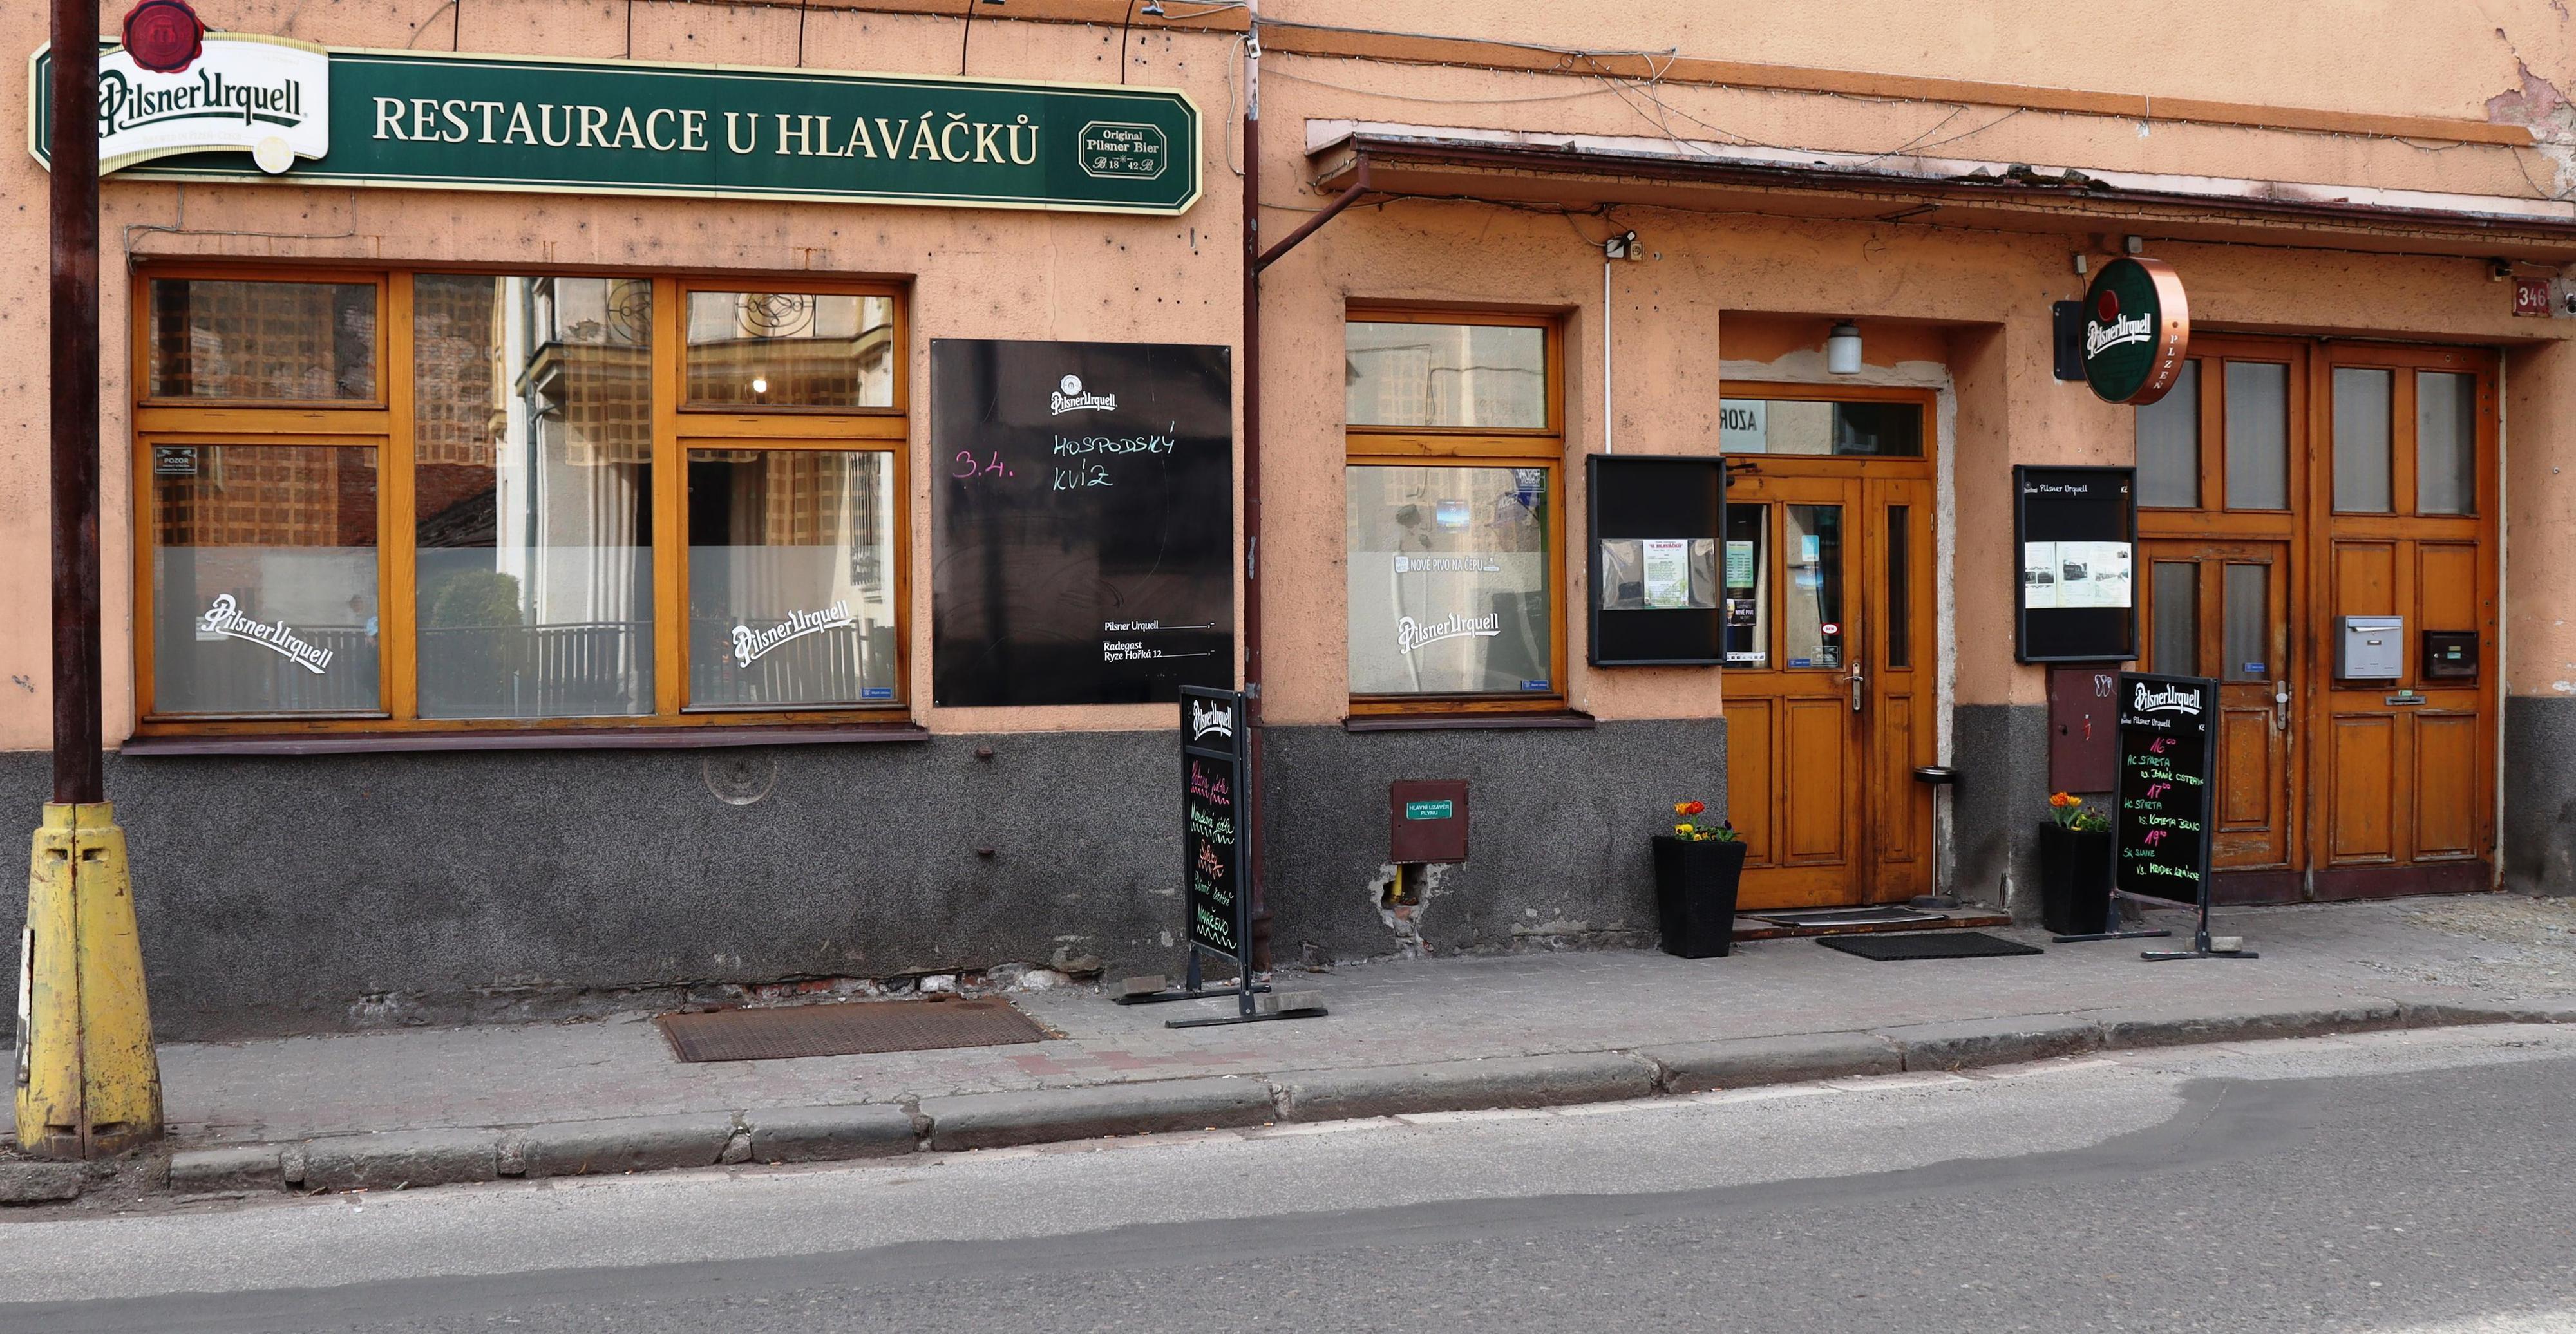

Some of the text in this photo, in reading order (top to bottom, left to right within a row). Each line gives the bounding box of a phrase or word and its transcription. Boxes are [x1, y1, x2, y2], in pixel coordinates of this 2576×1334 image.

[99, 67, 301, 138] Pilsner Urquell
[372, 97, 1039, 165] RESTAURACE U HLAVÁČKŮ
[1103, 130, 1142, 141] Original
[1086, 139, 1159, 153] Pilsner Bier
[1109, 160, 1119, 169] 18
[2519, 287, 2546, 306] 346
[2087, 313, 2152, 360] Pilsner Urquell
[1050, 390, 1116, 416] Pilsner Urquell
[1053, 420, 1175, 457] HOSPODSKÝ
[952, 450, 1113, 491] 3.4. KVÍZ
[2040, 484, 2062, 493] Pilsner
[2065, 484, 2088, 496] Urquell
[1410, 556, 1430, 571] NOVÉ
[1433, 558, 1449, 570] PIVO
[1452, 558, 1463, 570] NA
[1464, 556, 1482, 571] ČEPU
[200, 594, 334, 668] Pilsner Urquell
[732, 599, 849, 668] Pilsner Urquell
[1104, 620, 1159, 632] Pilsner Urquell
[1398, 612, 1499, 655] Pilsner Urquell
[1104, 641, 1142, 652] Radegast
[1104, 649, 1162, 662] Ryze Hořká 12
[2134, 682, 2169, 711] Pilsner
[2166, 682, 2201, 715] Urquell
[1193, 700, 1233, 741] Pilsner Urquell
[2133, 716, 2150, 726] Pilsner
[2152, 718, 2171, 730] Urquell
[2127, 754, 2137, 766] AC
